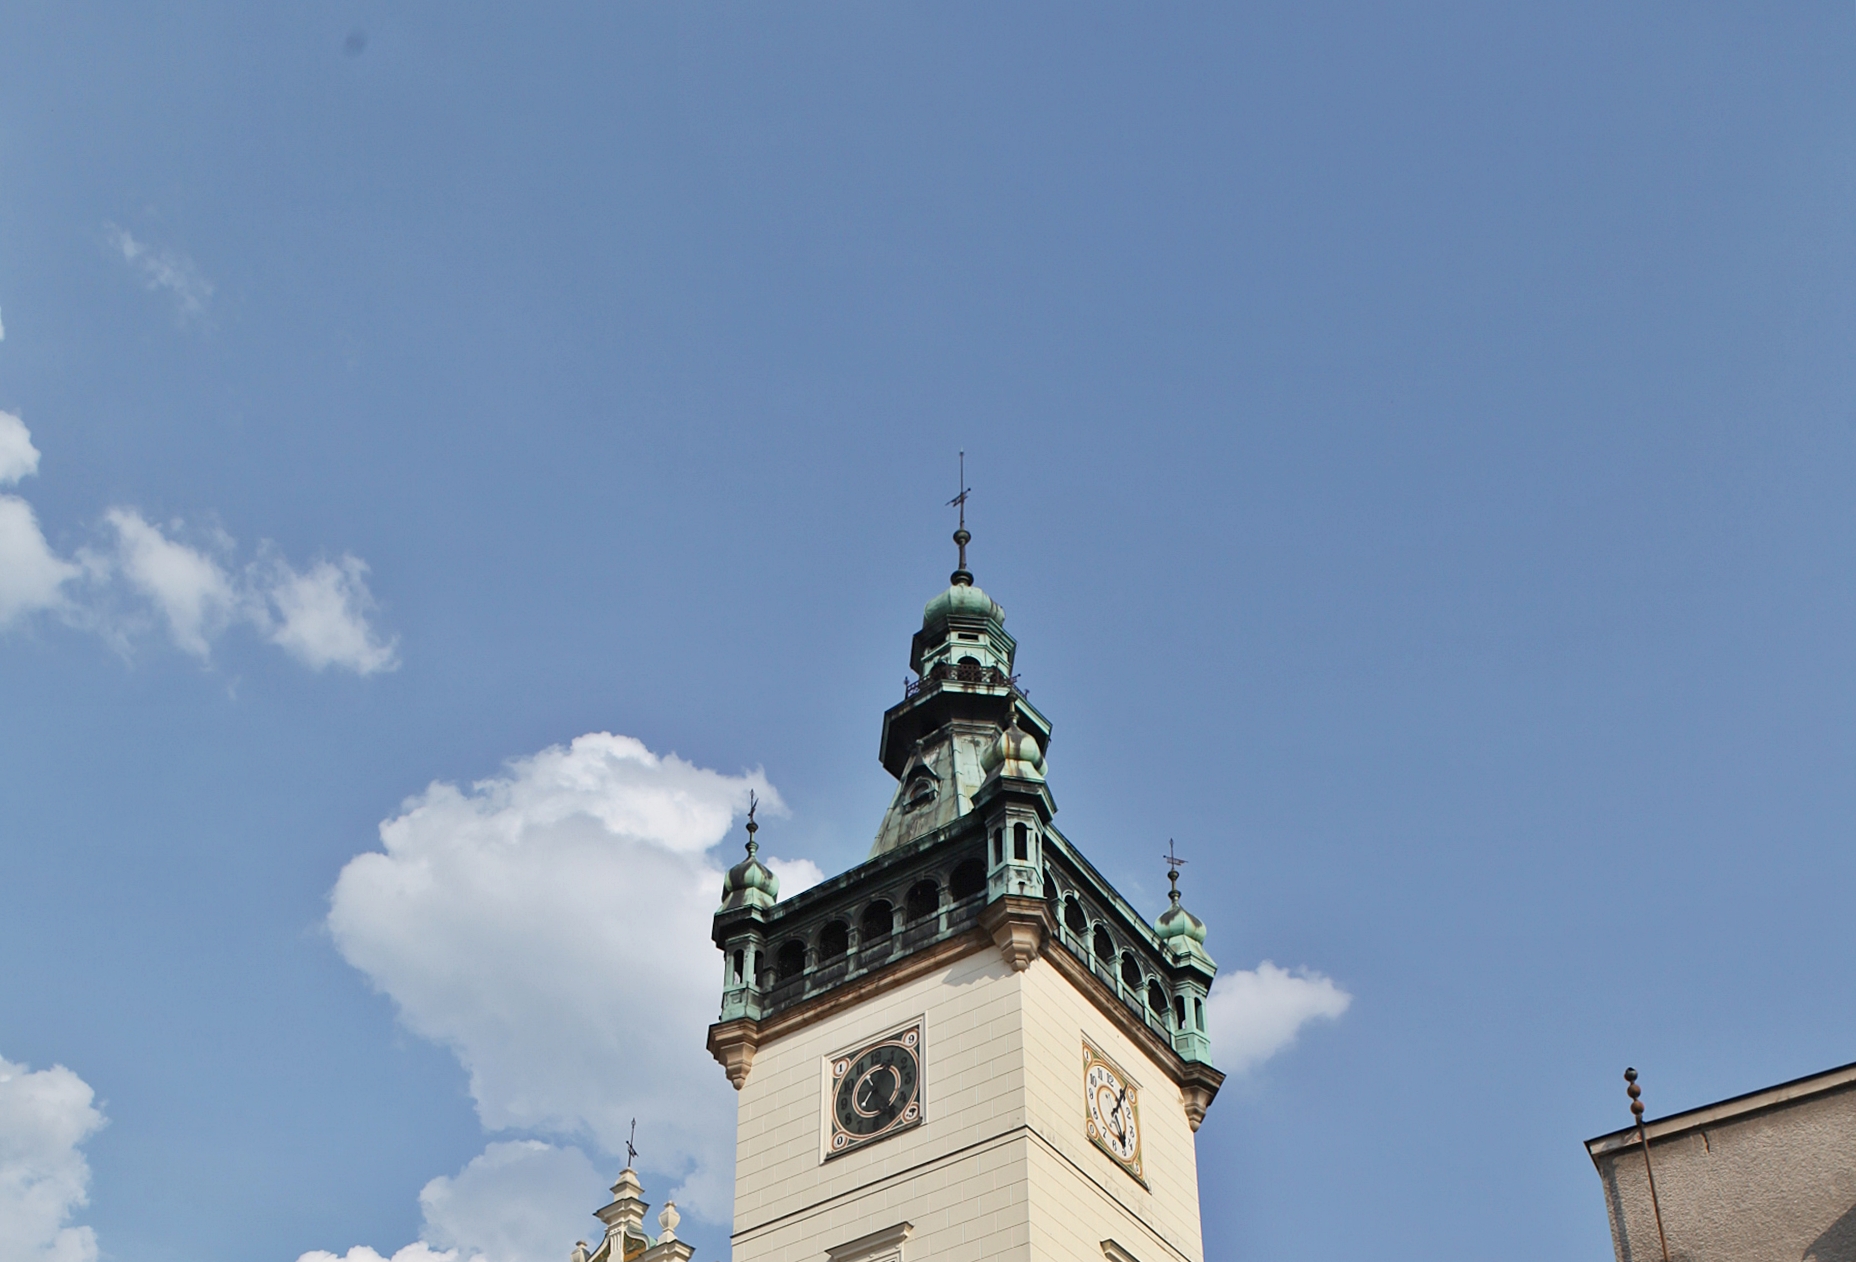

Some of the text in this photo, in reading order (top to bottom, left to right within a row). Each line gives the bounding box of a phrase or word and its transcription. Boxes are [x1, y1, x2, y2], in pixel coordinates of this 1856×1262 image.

[908, 1034, 915, 1044] 9
[870, 1051, 881, 1065] 12
[900, 1057, 908, 1070] 2
[839, 1064, 843, 1073] 1
[856, 1062, 864, 1075] 11
[1097, 1067, 1103, 1081] 11
[844, 1078, 854, 1092] 10
[1089, 1073, 1097, 1088] 10
[1106, 1072, 1115, 1088] 12
[840, 1097, 848, 1110] 9
[845, 1112, 852, 1125] 8
[1126, 1107, 1131, 1120] 2
[1102, 1126, 1107, 1139] 7
[837, 1136, 843, 1145] 0
